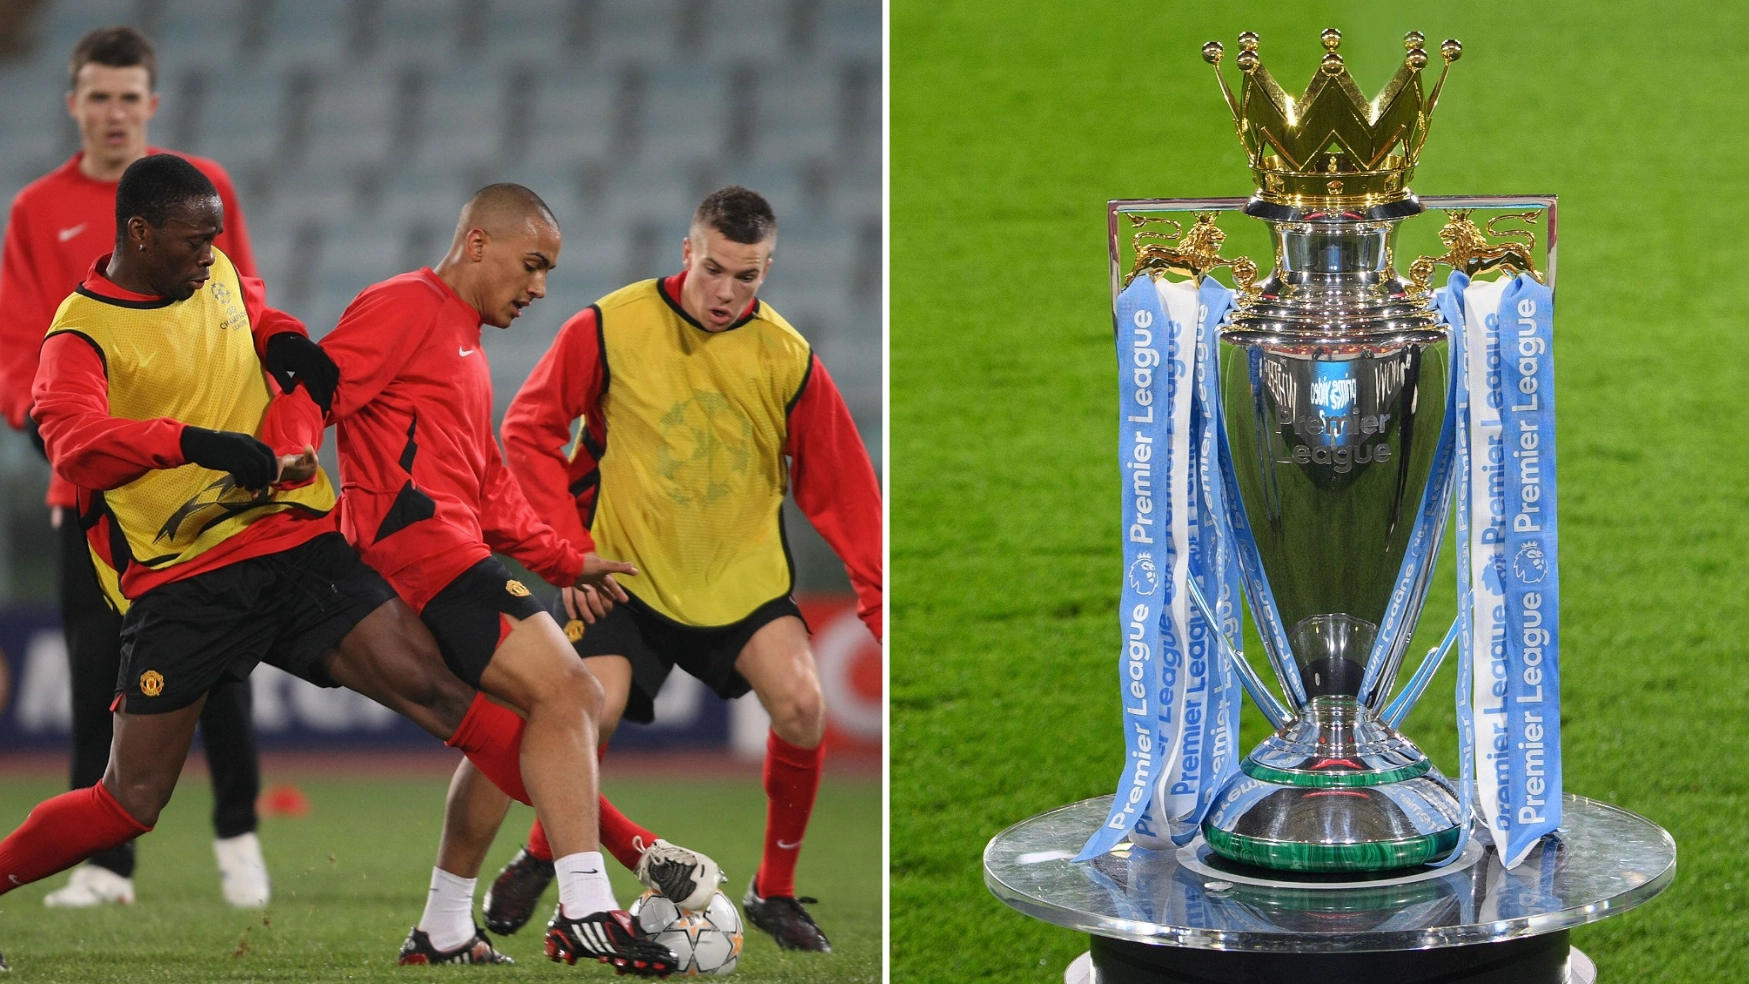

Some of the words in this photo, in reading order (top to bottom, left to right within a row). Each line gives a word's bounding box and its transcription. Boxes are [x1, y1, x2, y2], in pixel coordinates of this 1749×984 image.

[1127, 309, 1160, 423] League
[1511, 298, 1545, 412] League
[1275, 408, 1391, 435] Premier
[1276, 442, 1391, 473] League
[1513, 420, 1541, 534] Premier
[1127, 431, 1154, 544] Premier
[1480, 434, 1504, 546] Premier
[1127, 603, 1150, 716] League
[1158, 612, 1182, 724] League
[1483, 604, 1508, 715] League
[1516, 591, 1550, 704] League
[1109, 722, 1151, 830] Premier
[1170, 698, 1201, 796] Premier
[1486, 720, 1509, 831] Premier
[1517, 711, 1545, 825] Premier
